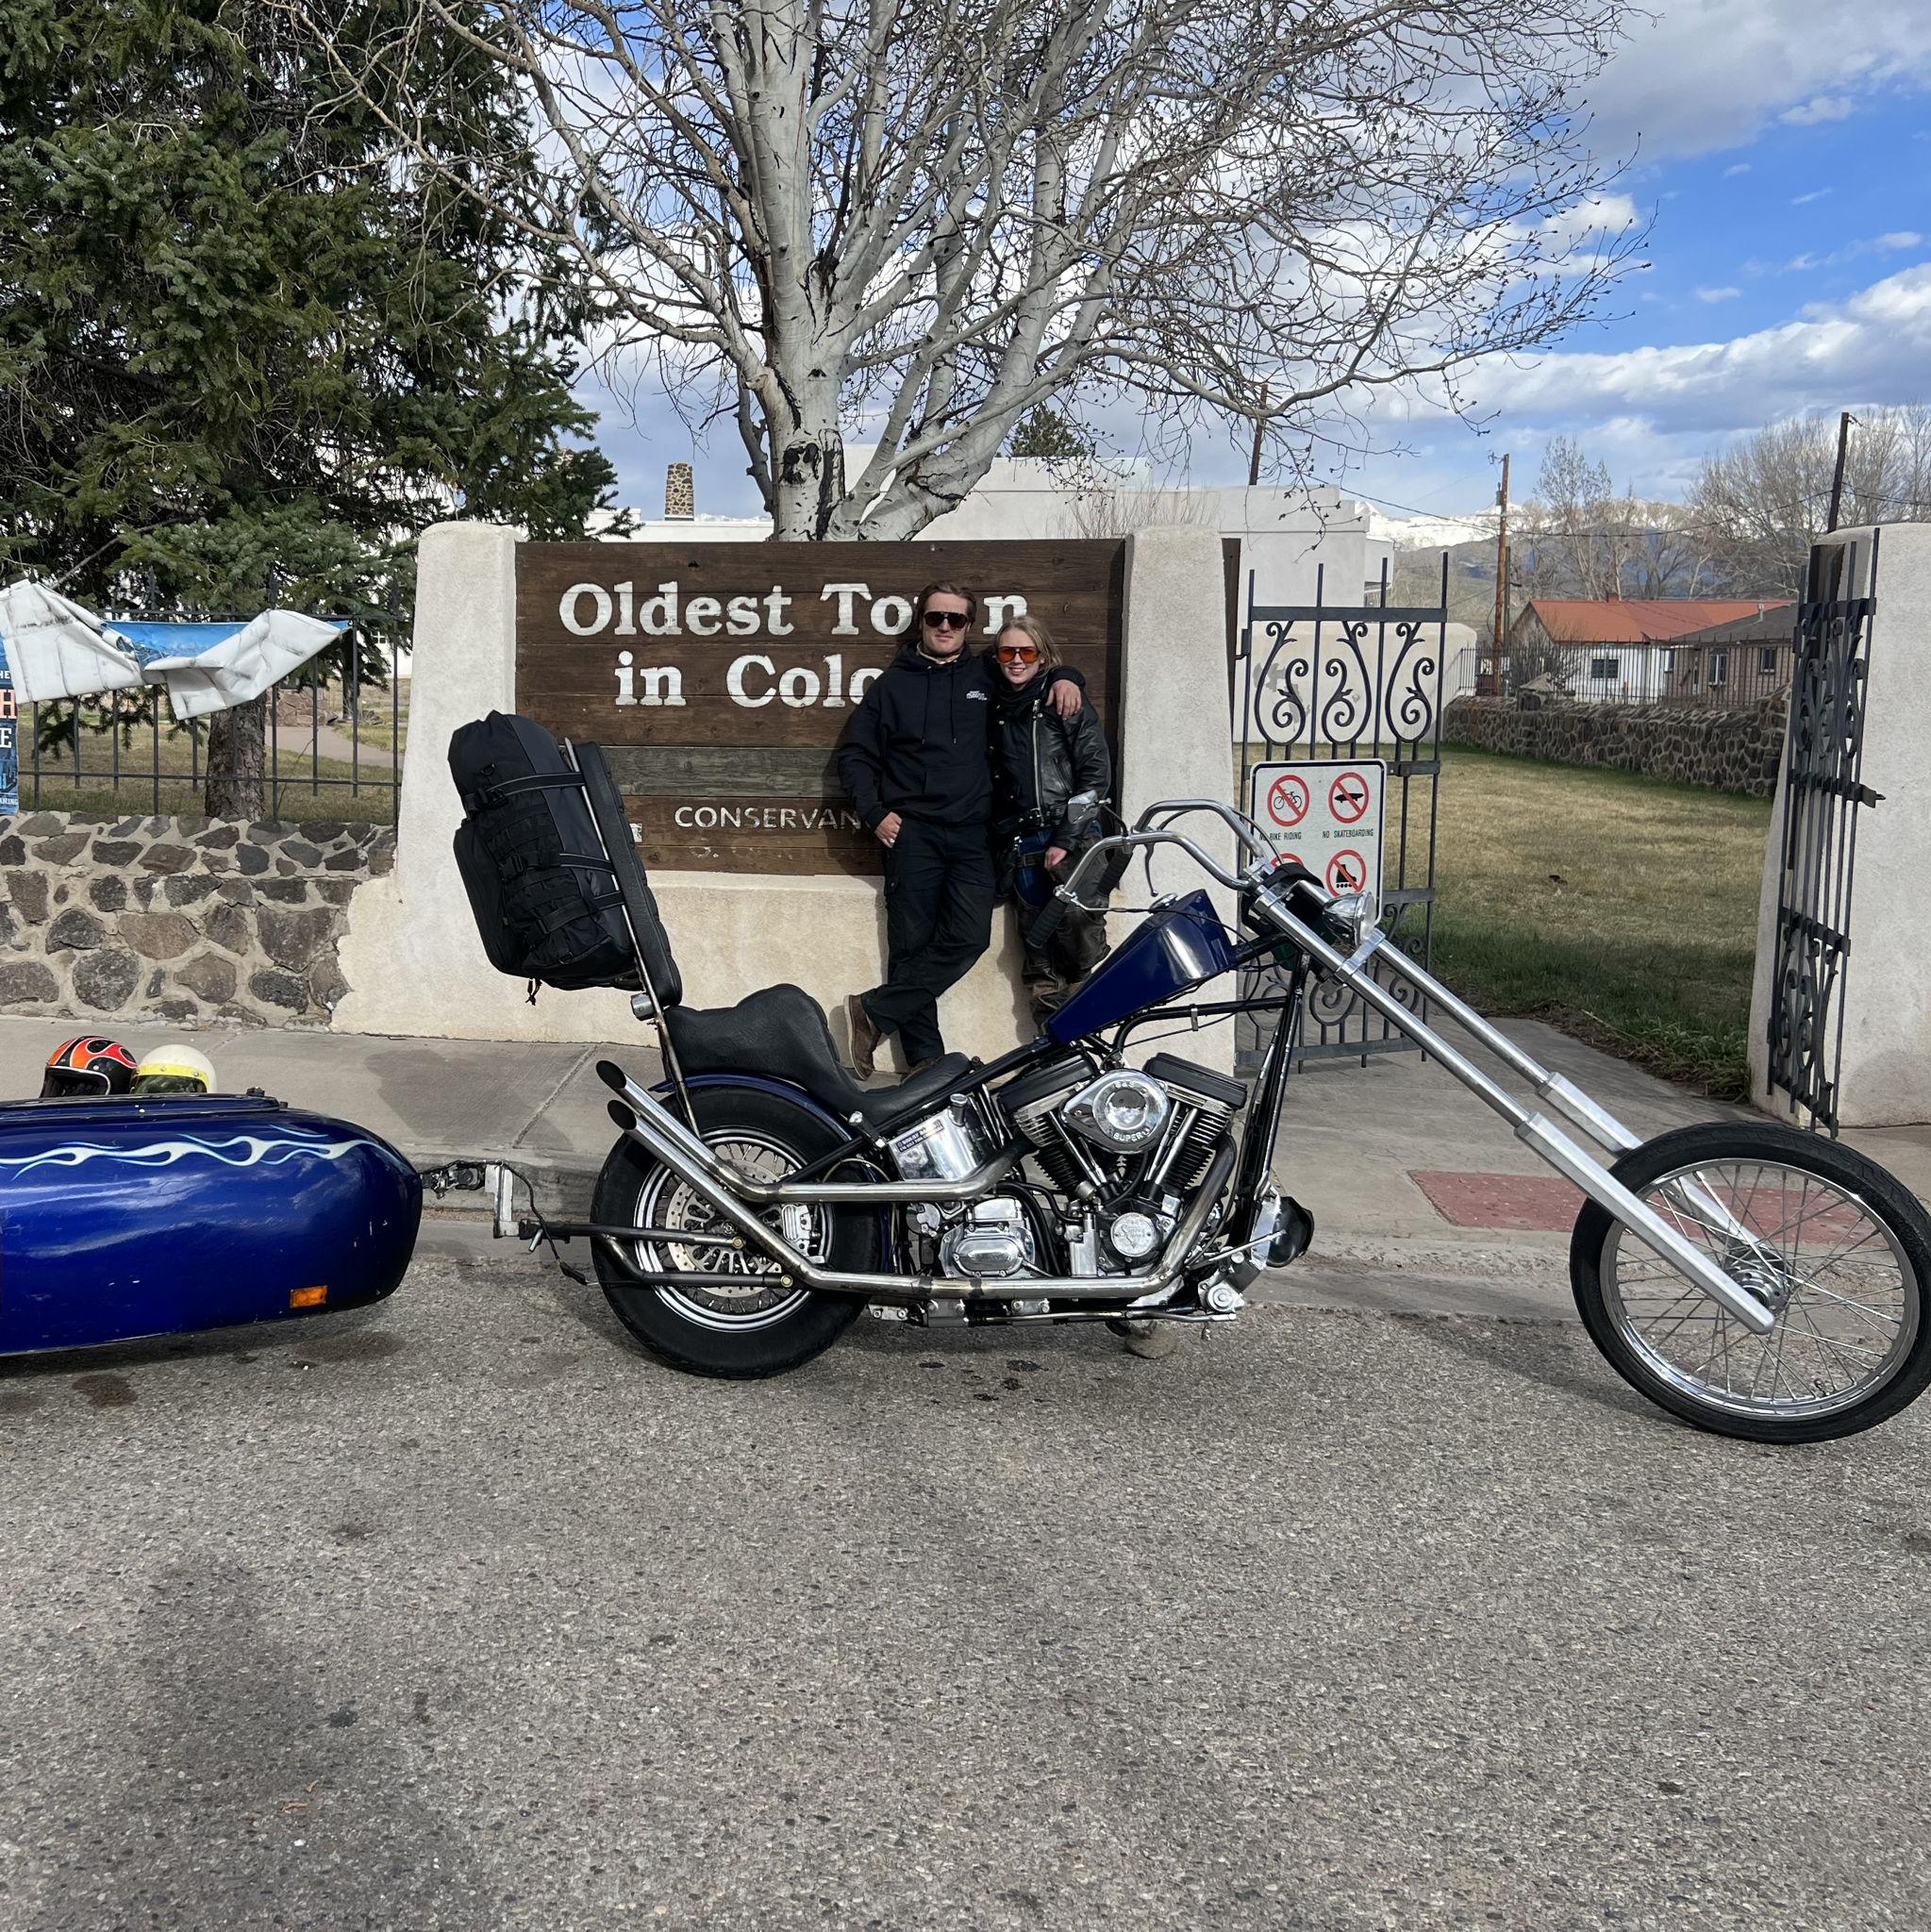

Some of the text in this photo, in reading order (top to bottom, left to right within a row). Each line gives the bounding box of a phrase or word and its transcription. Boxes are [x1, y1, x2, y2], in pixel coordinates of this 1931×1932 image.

[558, 580, 1028, 637] Oldest Ton
[614, 650, 687, 707] in
[1283, 831, 1302, 841] RIDING
[1322, 828, 1374, 839] NO SKATEBOARDING
